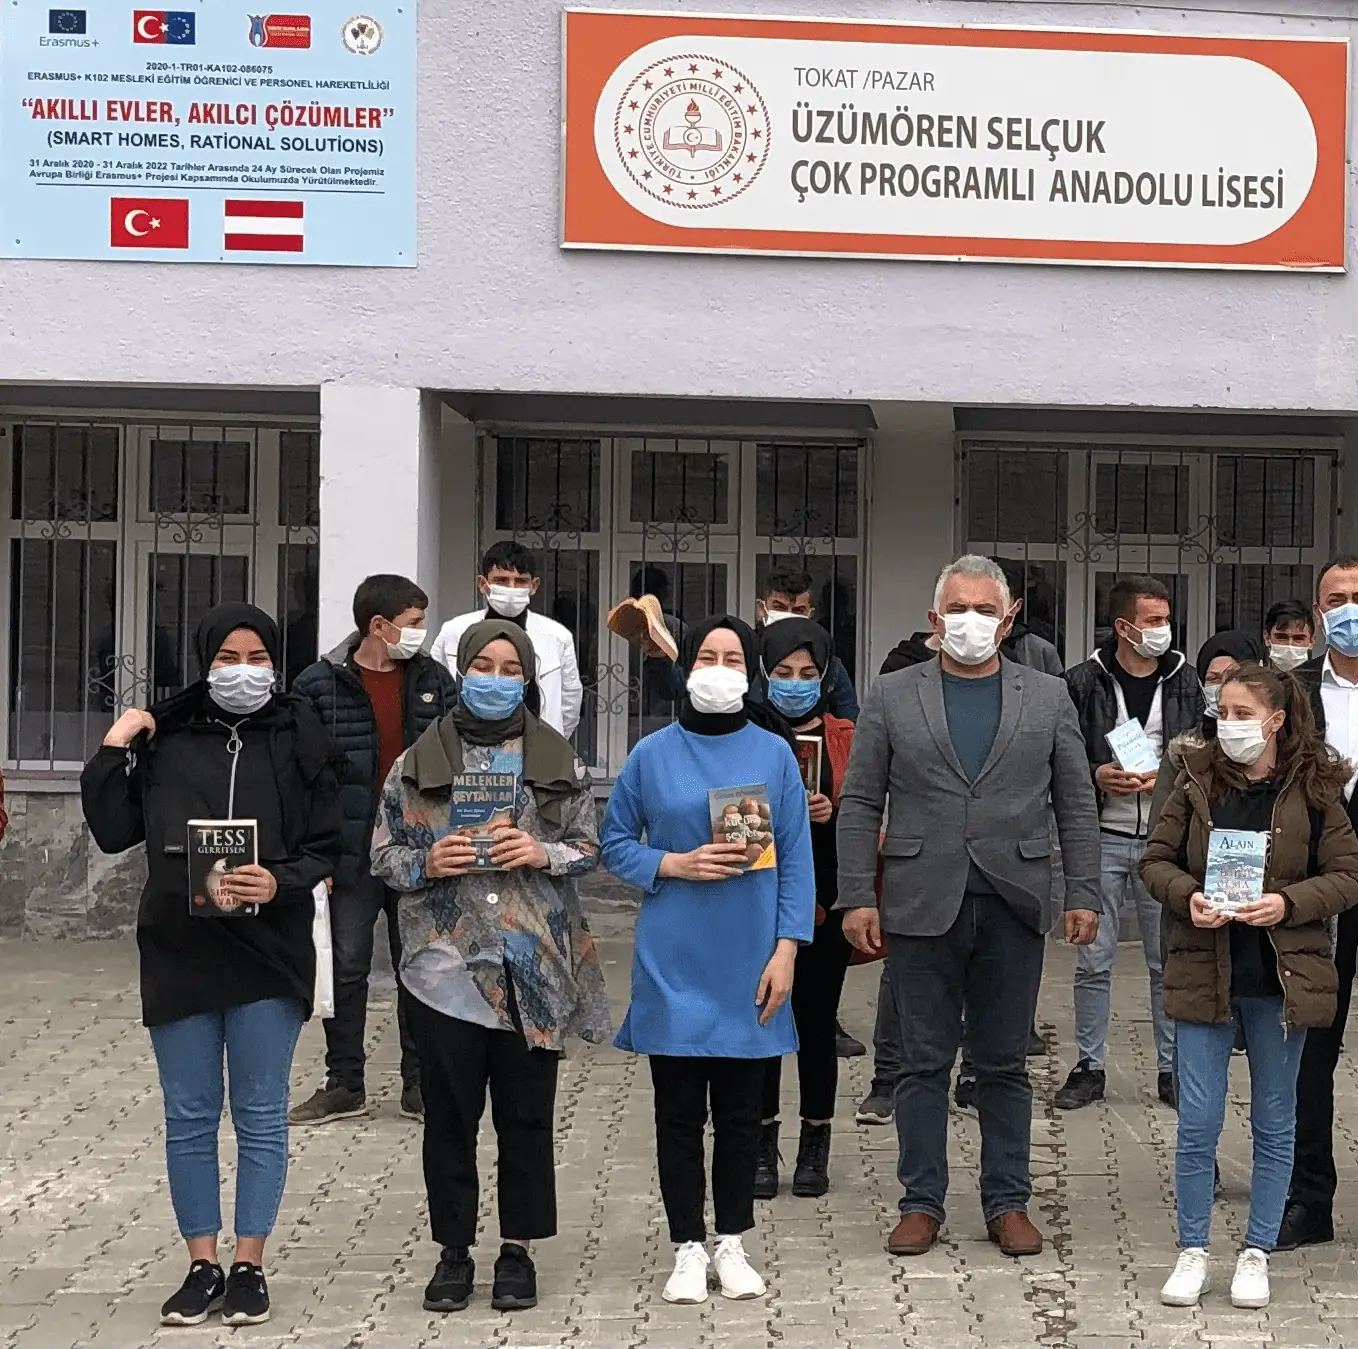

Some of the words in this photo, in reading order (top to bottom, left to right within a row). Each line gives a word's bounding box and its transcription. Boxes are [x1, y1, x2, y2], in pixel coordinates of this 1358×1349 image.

[39, 36, 100, 48] Erasmus+
[27, 72, 82, 81] ERASMUS+
[85, 73, 109, 82] K102
[111, 73, 155, 83] MESLEKİ
[157, 74, 191, 84] EĞİTİM
[244, 78, 258, 86] VE
[260, 79, 313, 88] PERSONEL
[794, 66, 859, 89] TOKAT
[863, 68, 936, 93] /PAZAR
[106, 100, 181, 126] EVLER,
[188, 102, 257, 125] AKILCI
[47, 130, 113, 148] (SMART
[118, 132, 185, 150] HOMES,
[791, 100, 978, 149] ÜZÜMÖREN
[986, 114, 1107, 164] SELÇUK
[29, 159, 40, 167] 31
[72, 160, 94, 168] 2020
[103, 161, 113, 169] 31
[146, 162, 168, 171] 2022
[252, 165, 263, 173] 24
[265, 165, 277, 176] Ay
[320, 166, 341, 175] Olan
[344, 167, 385, 177] Projemiz
[29, 170, 63, 180] Avrupa
[790, 158, 849, 204] ÇOK
[858, 162, 1036, 203] PROGRAMLI
[1049, 171, 1194, 207] ANADOLU
[1202, 168, 1286, 209] LİSESİ
[453, 775, 513, 786] MELEKLER
[197, 829, 246, 846] TESS
